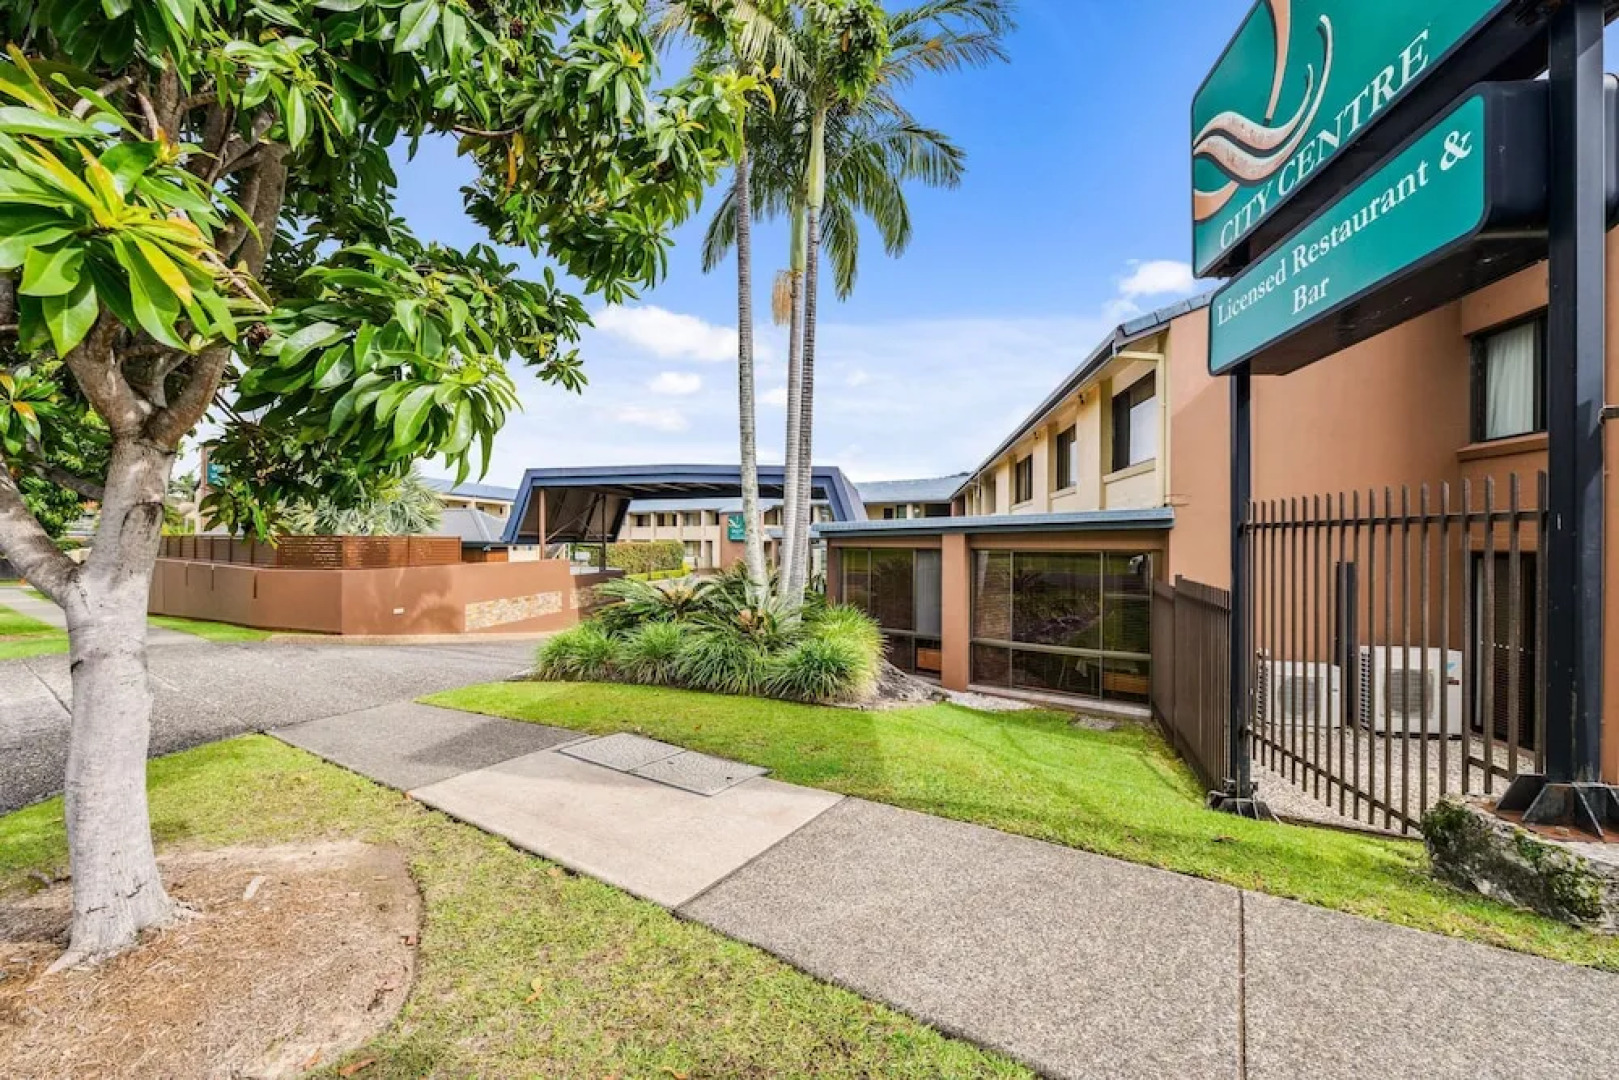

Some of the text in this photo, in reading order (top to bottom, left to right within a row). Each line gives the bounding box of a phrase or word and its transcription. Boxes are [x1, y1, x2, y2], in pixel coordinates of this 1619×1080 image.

[1217, 129, 1473, 326] Licensed Restaurant &
[1219, 29, 1429, 250] CITY CENTRE
[1292, 277, 1330, 315] Bar
